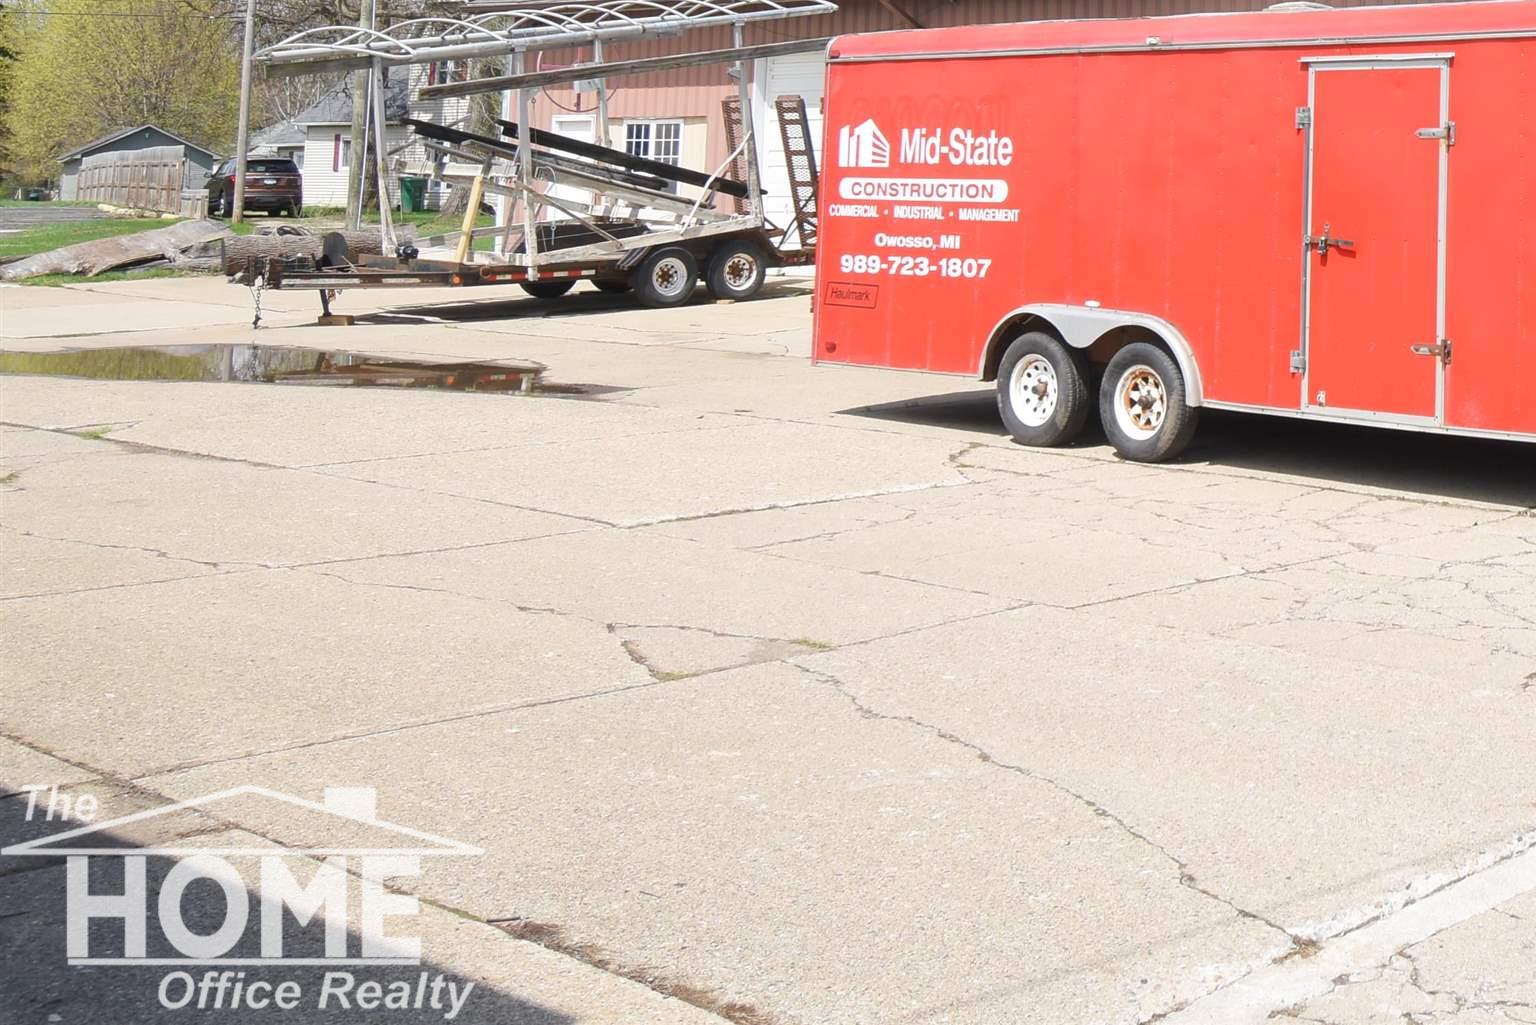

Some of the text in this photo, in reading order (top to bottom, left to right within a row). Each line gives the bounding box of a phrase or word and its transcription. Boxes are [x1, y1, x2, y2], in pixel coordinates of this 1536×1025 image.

[900, 127, 1013, 166] Mid-State
[851, 182, 994, 199] CONSTRUCTION
[829, 204, 1020, 222] COMMERCIAL INDUSTRIAL MANAGEMENT
[874, 233, 960, 250] Owosso, MI
[840, 255, 992, 278] 989-723-1807
[831, 287, 871, 302] Haulmark
